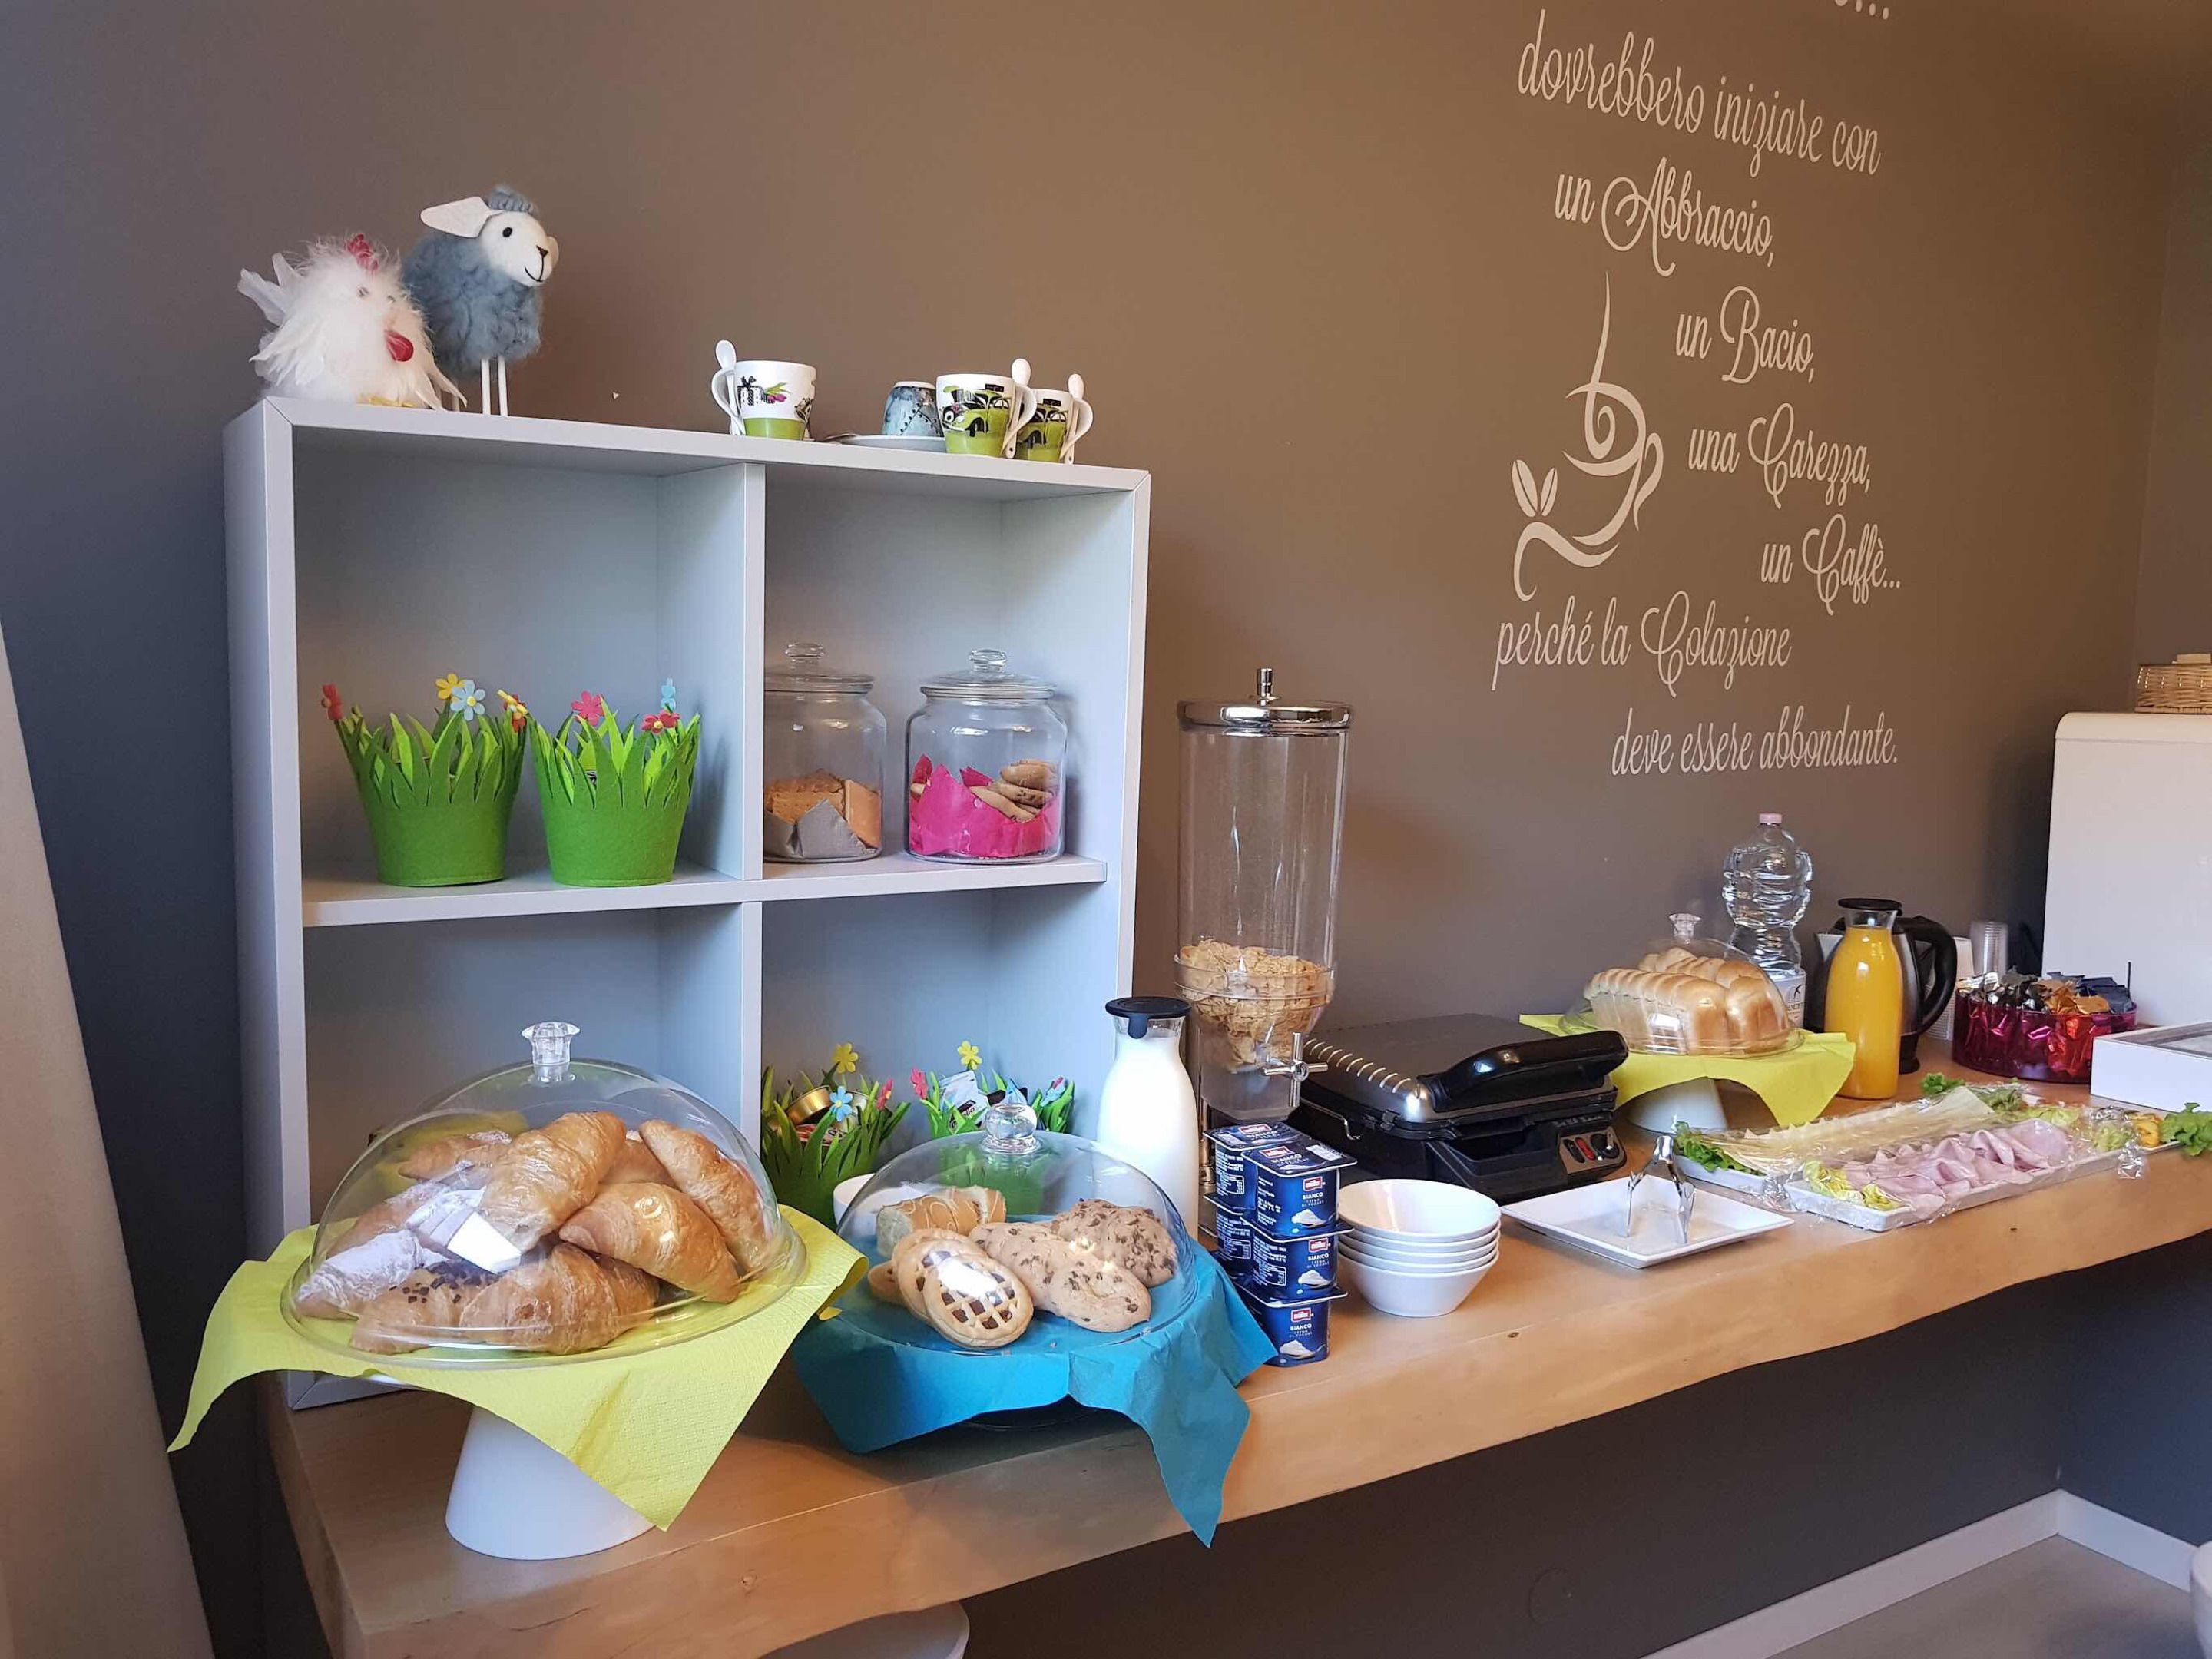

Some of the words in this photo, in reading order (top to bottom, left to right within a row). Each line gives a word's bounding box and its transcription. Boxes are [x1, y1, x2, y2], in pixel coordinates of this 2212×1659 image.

[1518, 8, 1704, 134] dovrebbero
[1714, 75, 1823, 178] iniziare
[1832, 121, 1882, 175] con
[1555, 174, 1596, 224] un
[1601, 156, 1774, 277] Abbraccio,
[1675, 313, 1713, 359] un
[1720, 286, 1814, 384] Bacio,
[1688, 429, 1740, 474] una
[1747, 402, 1871, 510] Carezza,
[1760, 543, 1793, 584] un
[1491, 595, 1595, 691] perché
[1601, 596, 1632, 666] la
[1640, 590, 1793, 698] Colazione
[1611, 707, 1674, 776] deve
[1680, 722, 1755, 773] essere
[1759, 704, 1898, 770] abbondante.
[1308, 1253, 1330, 1261] BIANCO
